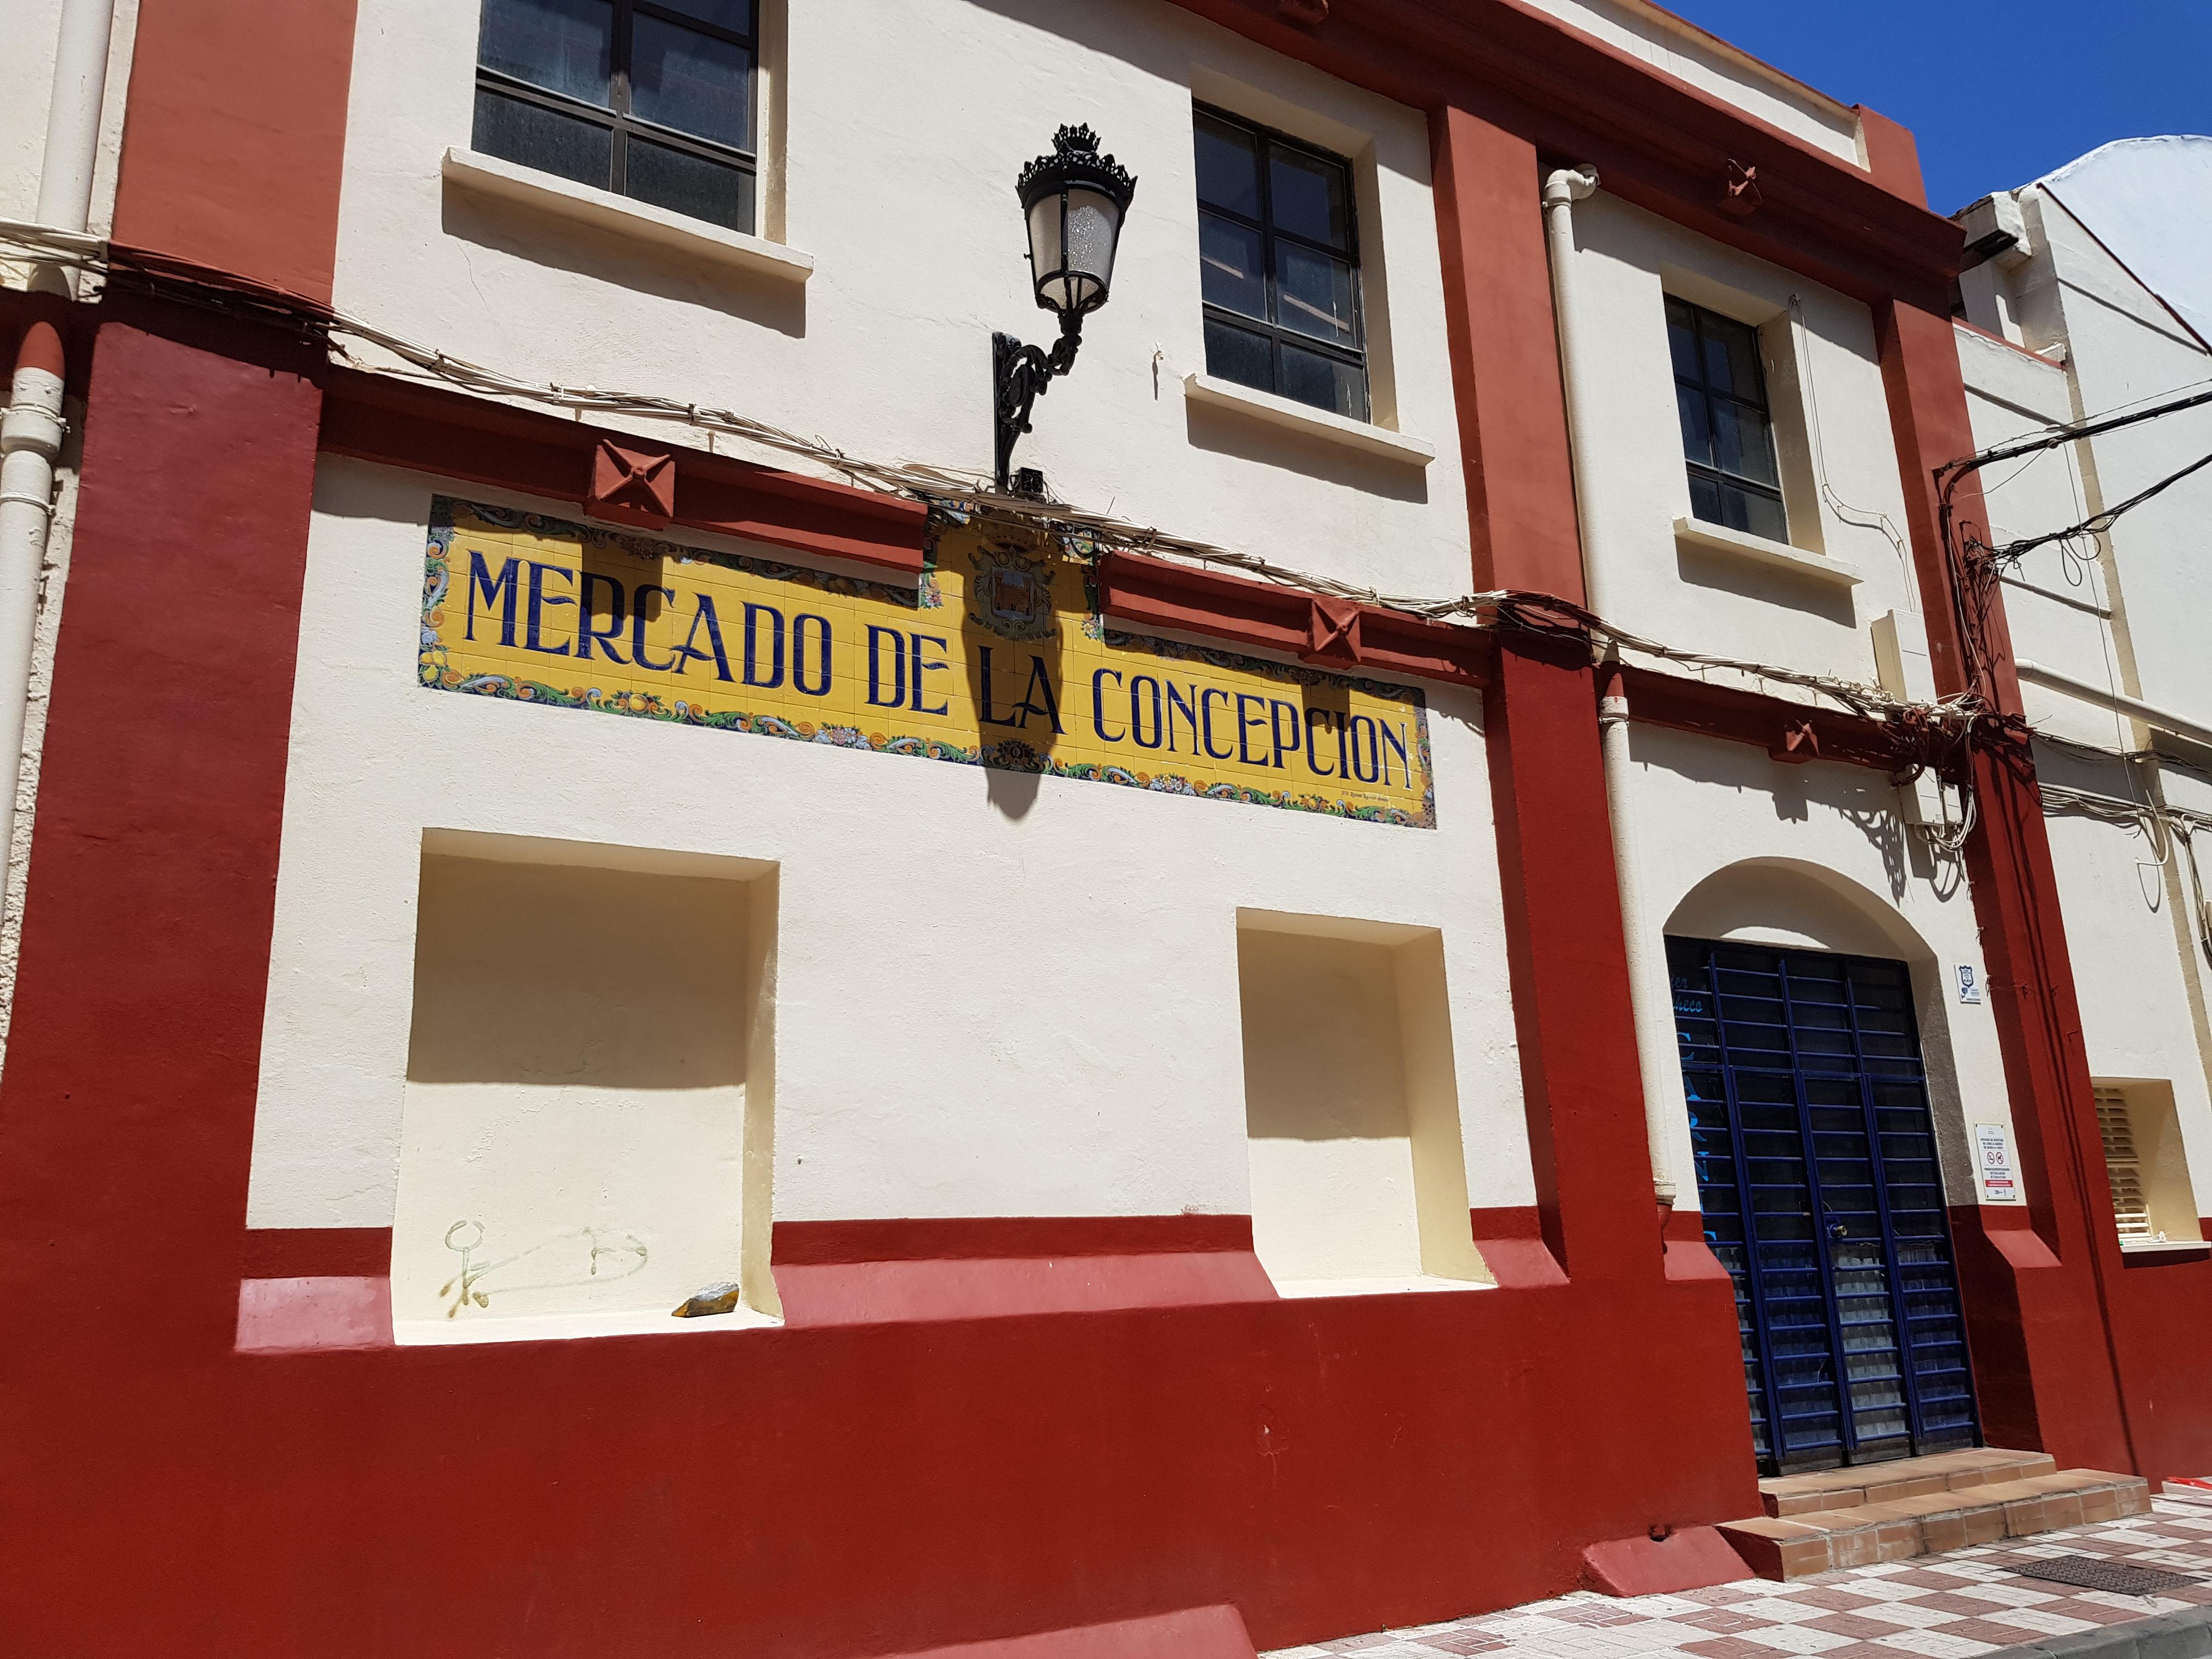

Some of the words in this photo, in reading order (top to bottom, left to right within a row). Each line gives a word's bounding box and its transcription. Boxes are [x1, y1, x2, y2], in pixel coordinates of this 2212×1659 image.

[464, 549, 833, 696] MERCADO
[864, 623, 950, 716] DE
[978, 645, 1066, 735] LA
[1092, 668, 1413, 790] CONCEPCION
